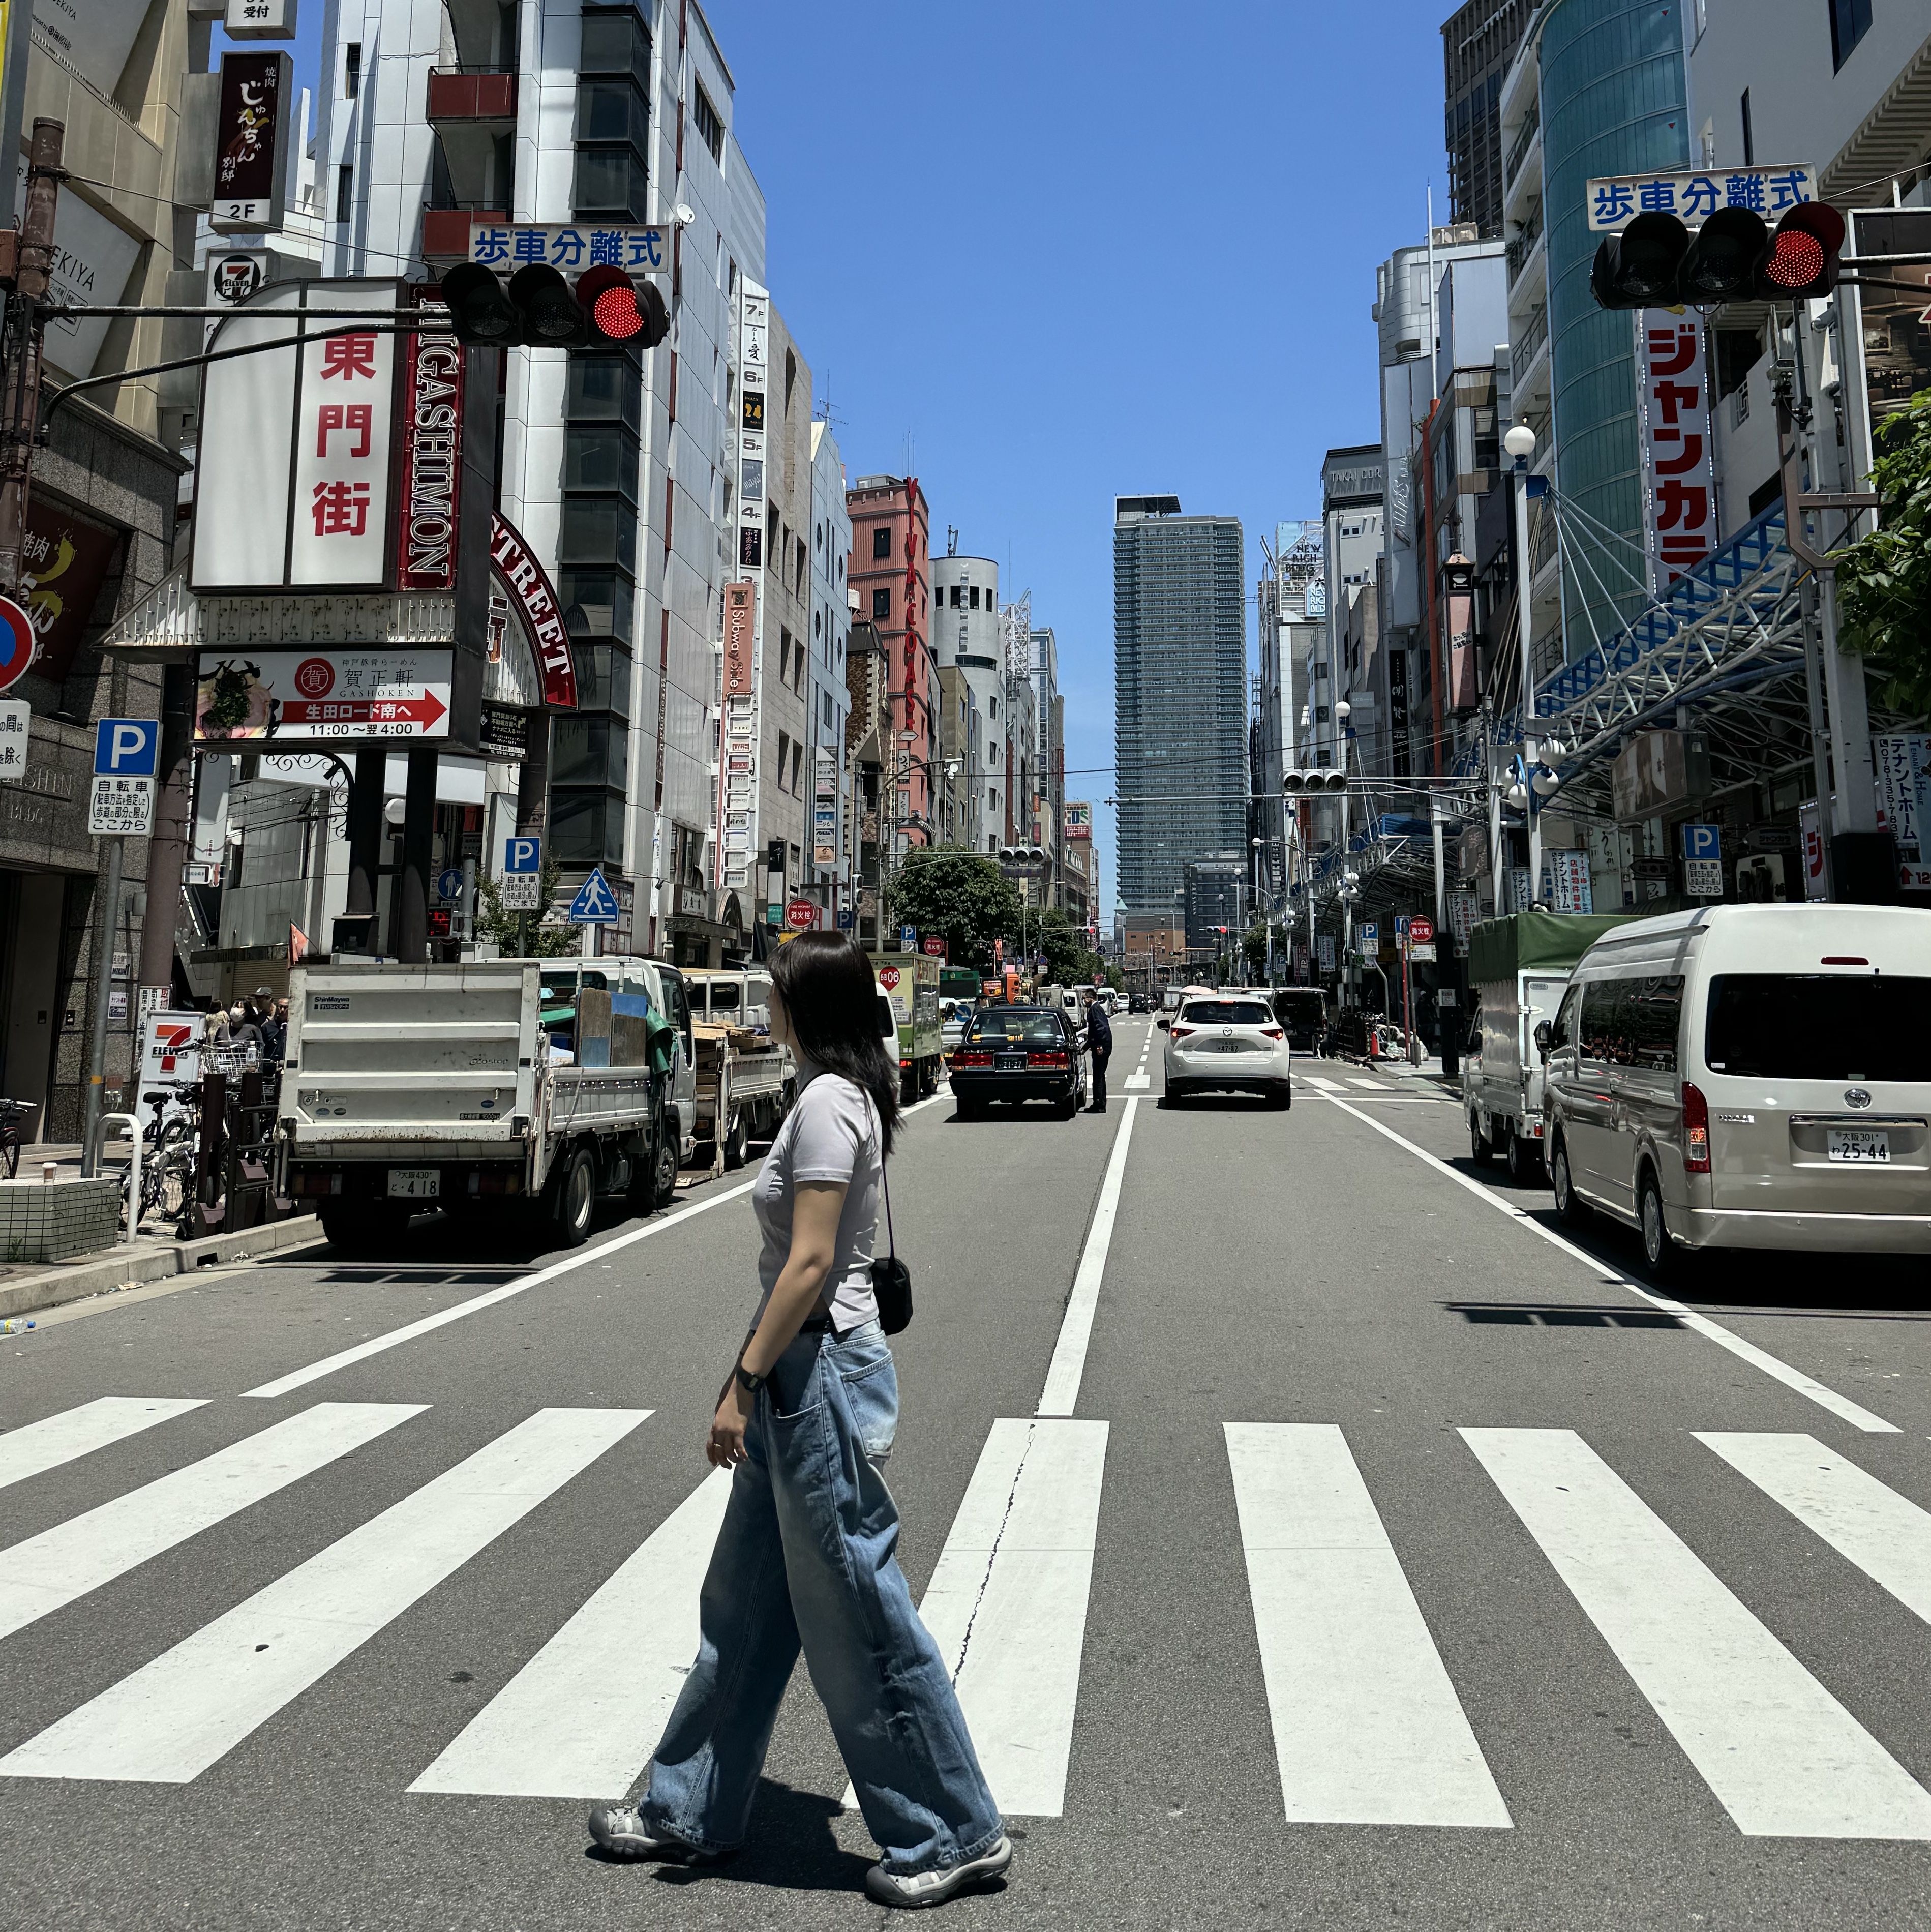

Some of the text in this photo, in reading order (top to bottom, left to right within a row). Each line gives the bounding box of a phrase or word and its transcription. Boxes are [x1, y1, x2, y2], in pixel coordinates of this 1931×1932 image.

[243, 6, 269, 19] 受付
[264, 67, 276, 87] 焼肉
[237, 80, 266, 163] じゅんちゃん
[1593, 170, 1810, 224] 歩車分離式
[230, 204, 256, 218] 2F
[474, 228, 662, 267] 歩車分離式
[745, 304, 765, 317] 7F
[744, 371, 764, 383] 6F
[312, 332, 378, 536] 東門街
[743, 438, 763, 451] 5F
[741, 507, 762, 519] 4F
[1296, 544, 1322, 553] NEW
[1292, 554, 1317, 563] RICH
[728, 609, 745, 661] Subway
[344, 668, 413, 689] 賀正軒
[340, 689, 415, 698] GASHOKEN
[305, 703, 412, 720] 生田ロード南へ
[310, 724, 349, 736] 11:00
[380, 723, 413, 735] 4:00
[110, 724, 146, 768] P
[98, 780, 148, 792] 自転車
[1891, 739, 1918, 840] テナントホーム
[1914, 781, 1927, 806] HOME
[93, 819, 146, 831] ここから
[1693, 828, 1713, 855] P
[514, 841, 534, 869] P
[507, 875, 536, 884] 自転車
[1558, 852, 1571, 908] テナントホーム
[1518, 871, 1527, 912] テナントホ
[790, 911, 811, 920] 消火栓
[839, 912, 849, 927] P
[905, 927, 914, 939] P
[1365, 924, 1375, 937] P
[1843, 1132, 1875, 1142] 大阪301
[1832, 1143, 1887, 1160] わ 25-44
[400, 1171, 429, 1179] 大阪430
